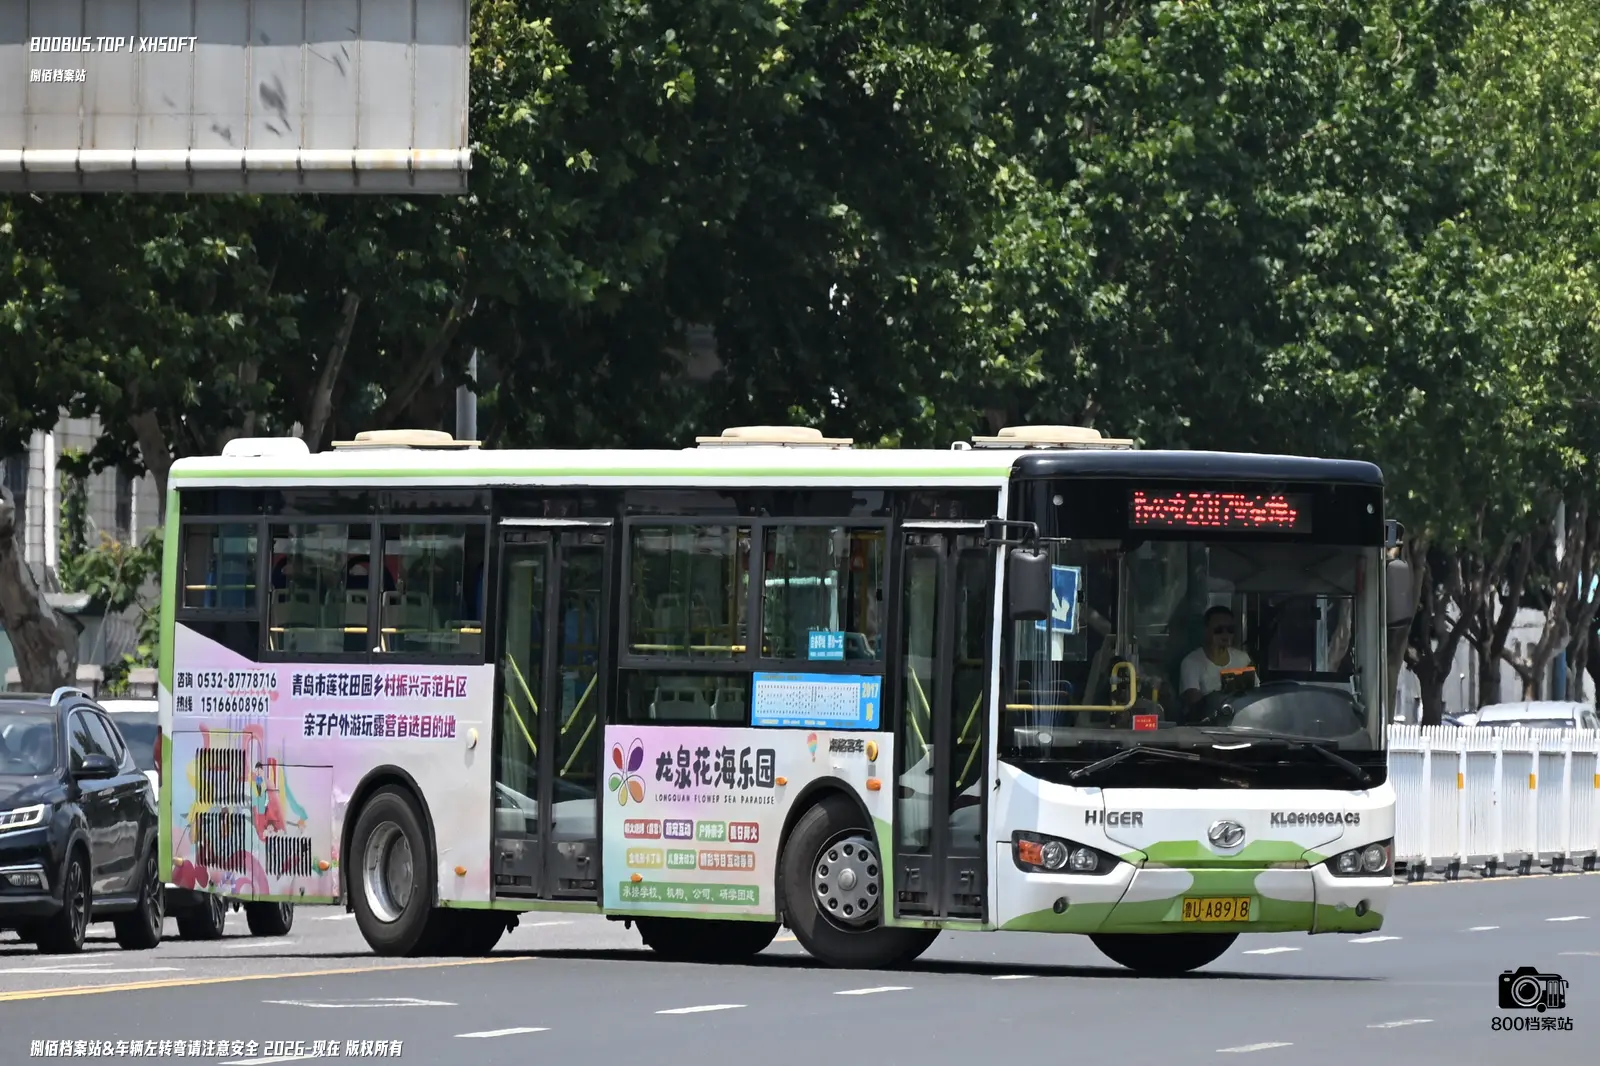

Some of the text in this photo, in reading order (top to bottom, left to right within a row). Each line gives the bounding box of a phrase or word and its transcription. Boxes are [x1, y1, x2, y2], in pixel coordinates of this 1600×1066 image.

[177, 672, 278, 689] 咨询 0532-87778716
[291, 673, 469, 699] 青岛市莲花田园乡村振兴示范片区
[862, 682, 879, 699] 2017
[176, 696, 270, 713] 热线 15166608961
[303, 713, 457, 738] 亲子户外游玩露营首选目的地
[655, 744, 776, 790] 龙泉花海乐园
[655, 794, 775, 805] LONGQUAN FLOWER SEA PARADISE
[1085, 810, 1144, 827] HIGER
